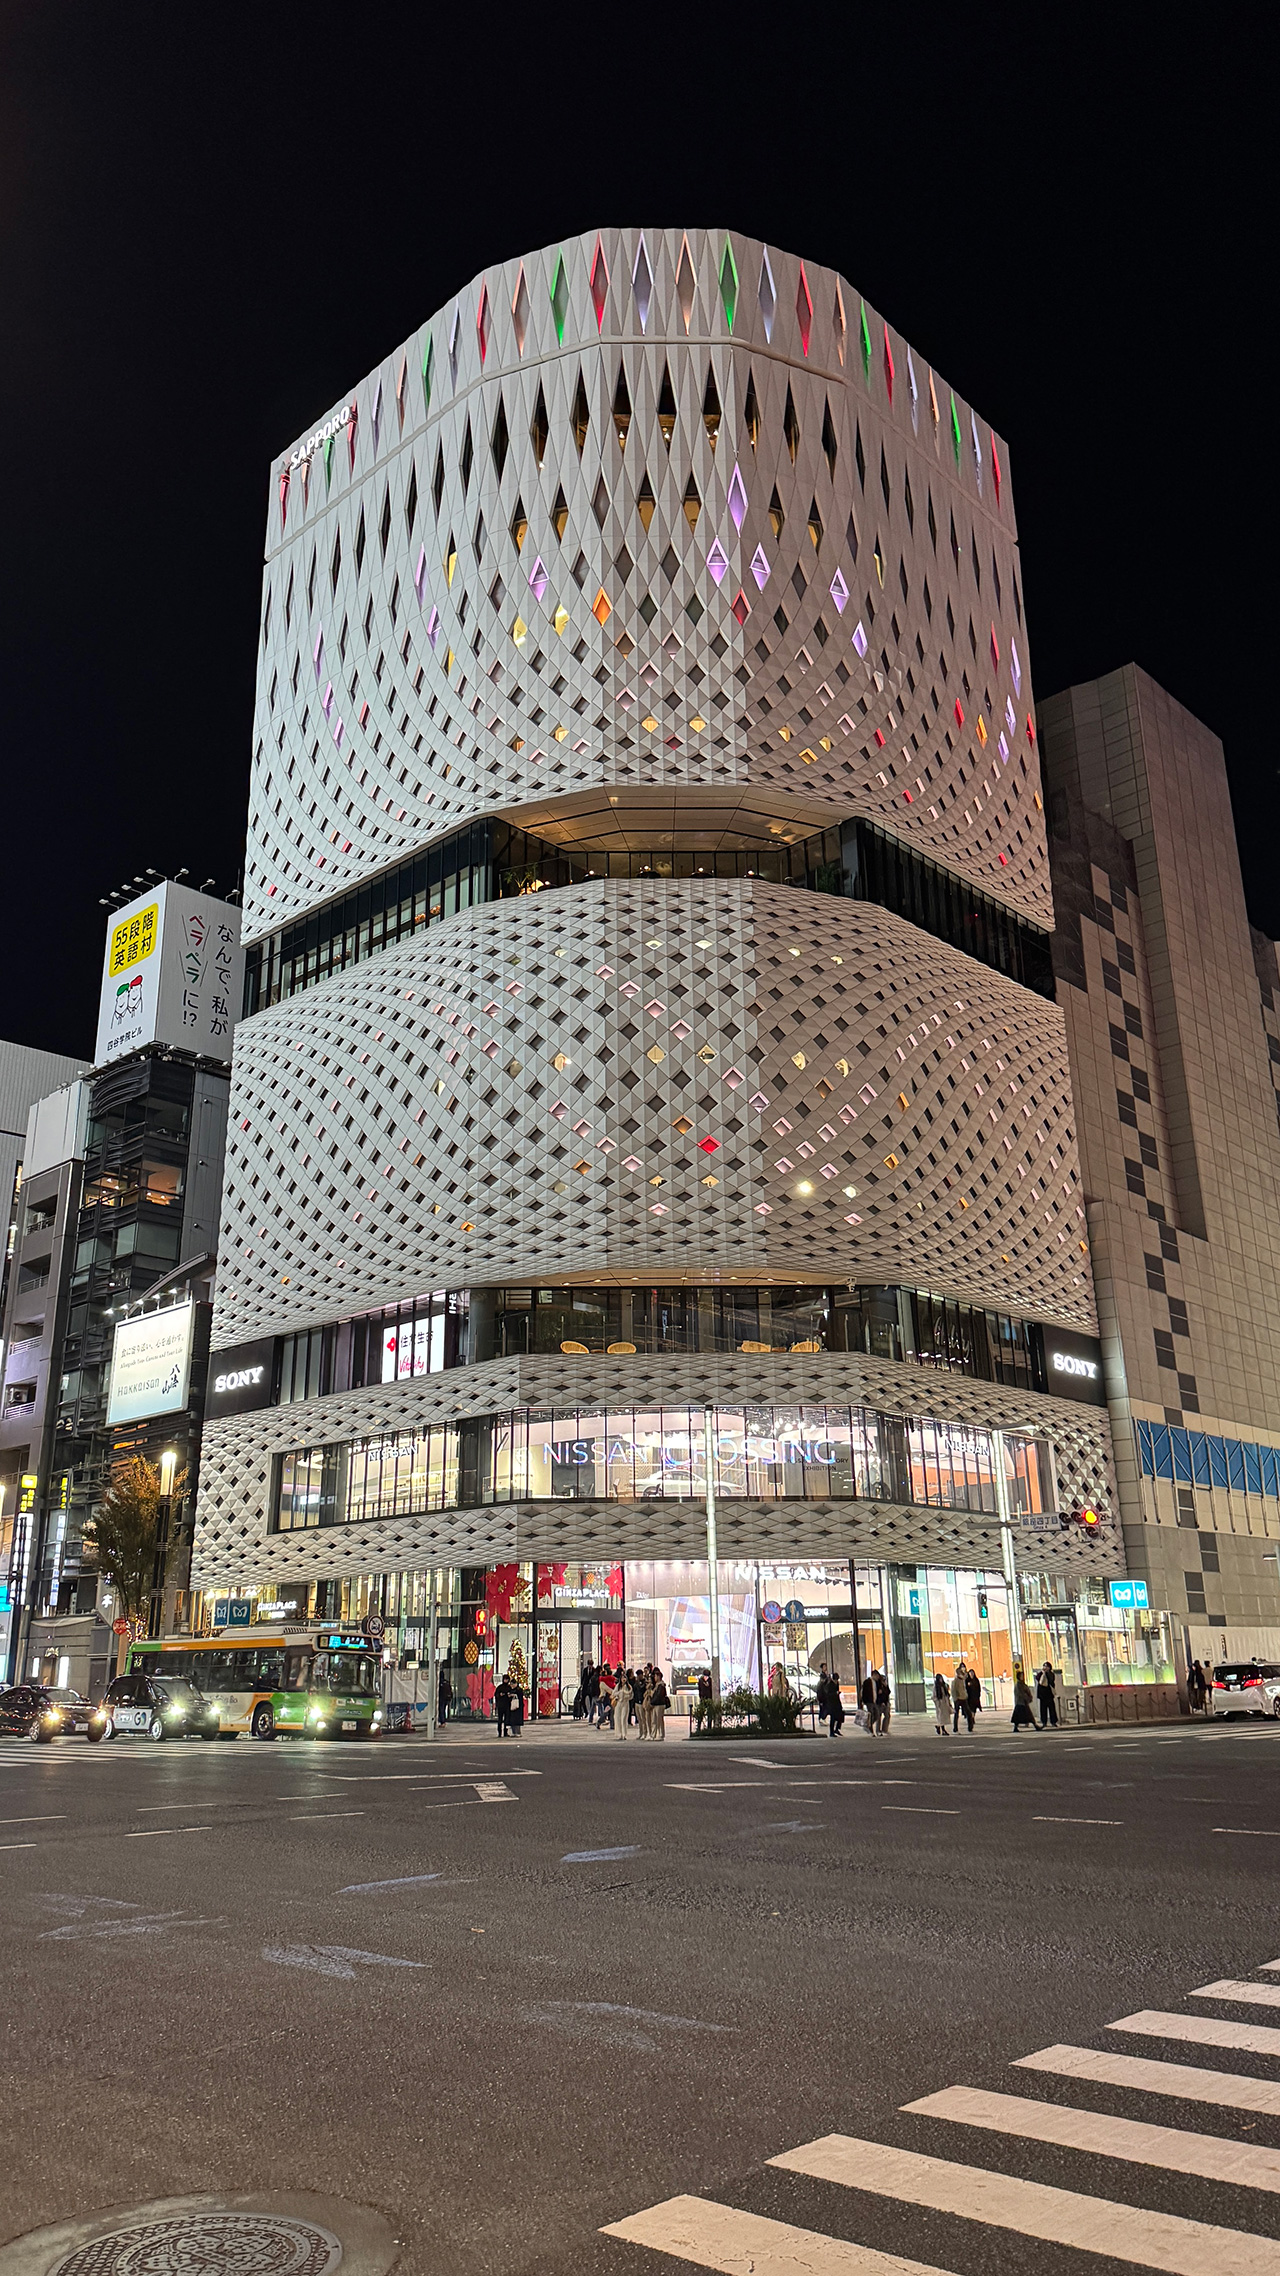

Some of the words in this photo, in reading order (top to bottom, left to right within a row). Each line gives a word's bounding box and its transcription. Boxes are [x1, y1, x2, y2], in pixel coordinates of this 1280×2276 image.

[290, 406, 350, 469] SAPPORO
[115, 911, 154, 948] 55段階
[114, 933, 152, 970] 英語村
[210, 924, 235, 1035] なんで、私が
[107, 1026, 143, 1051] 四谷学院ビル
[400, 1355, 425, 1374] Vitaity
[1053, 1353, 1096, 1378] SONY
[214, 1366, 264, 1392] SONY
[368, 1444, 417, 1461] NISSAN
[543, 1441, 647, 1465] NISSAN
[945, 1439, 989, 1456] NISSAN
[735, 1566, 826, 1580] NISSAN
[583, 1588, 610, 1598] PLACE
[133, 1711, 147, 1726] GO
